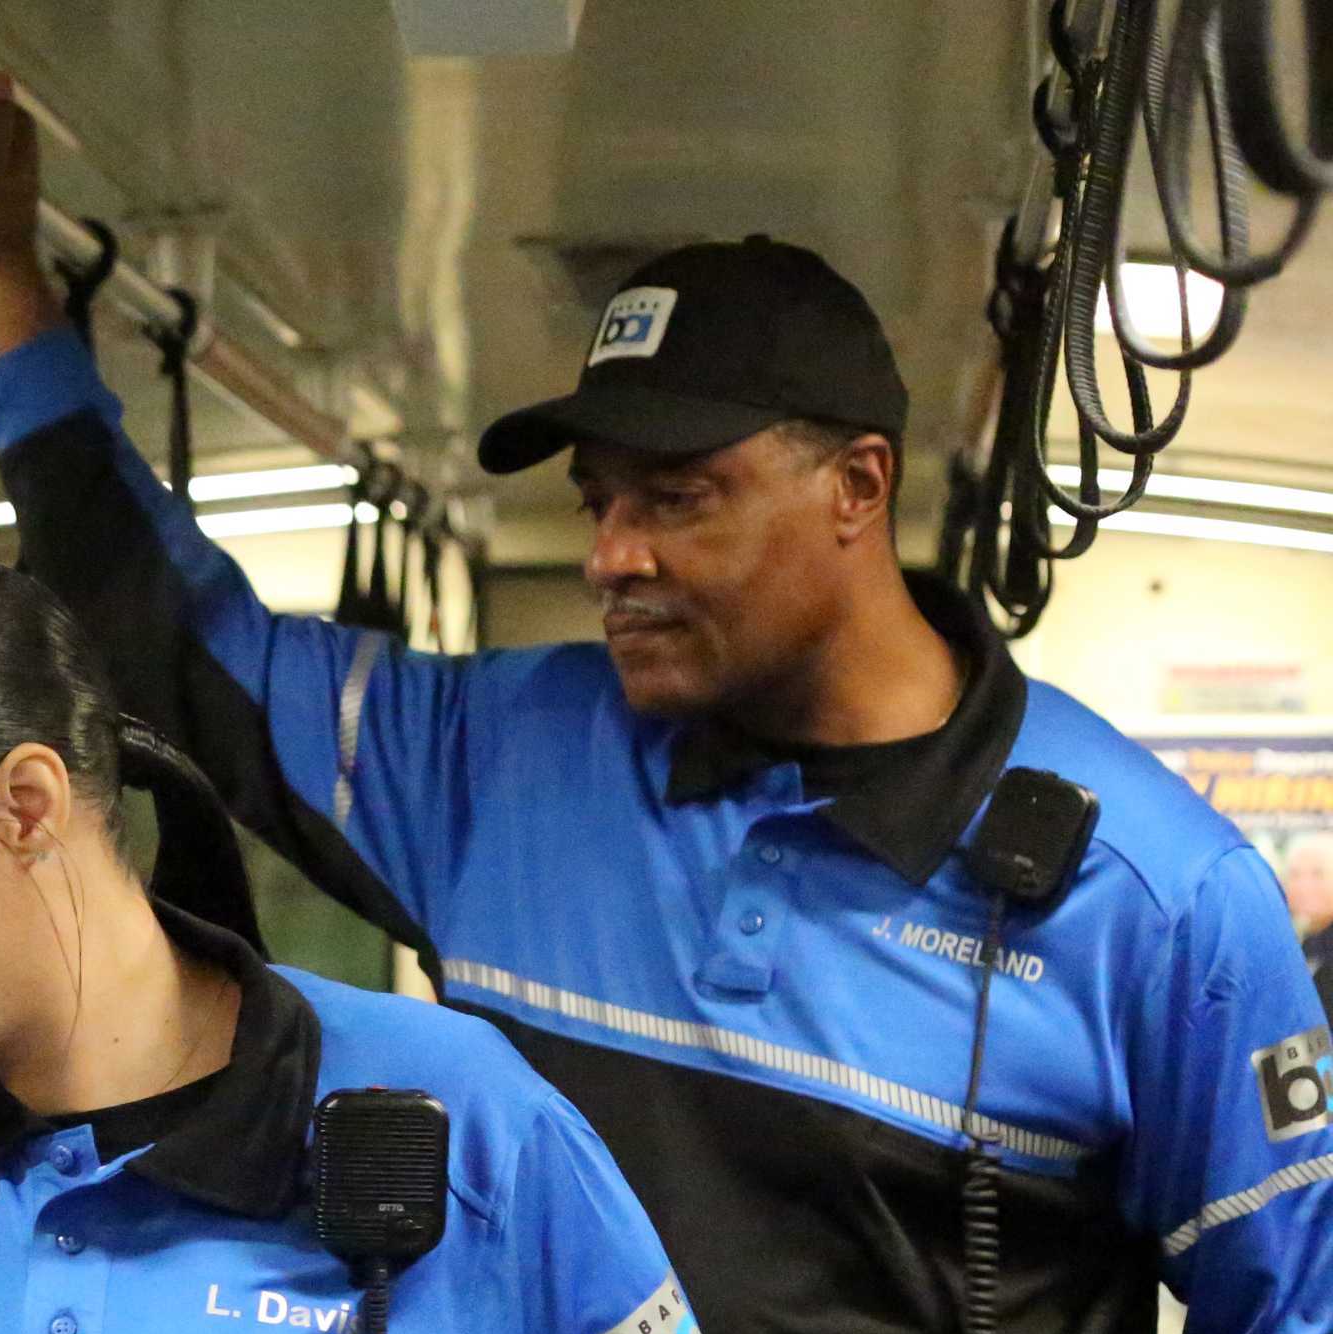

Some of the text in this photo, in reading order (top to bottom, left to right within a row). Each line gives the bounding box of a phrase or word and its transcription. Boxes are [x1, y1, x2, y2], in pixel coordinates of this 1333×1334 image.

[871, 916, 1045, 983] J. MORELAND
[206, 1283, 242, 1319] L.
